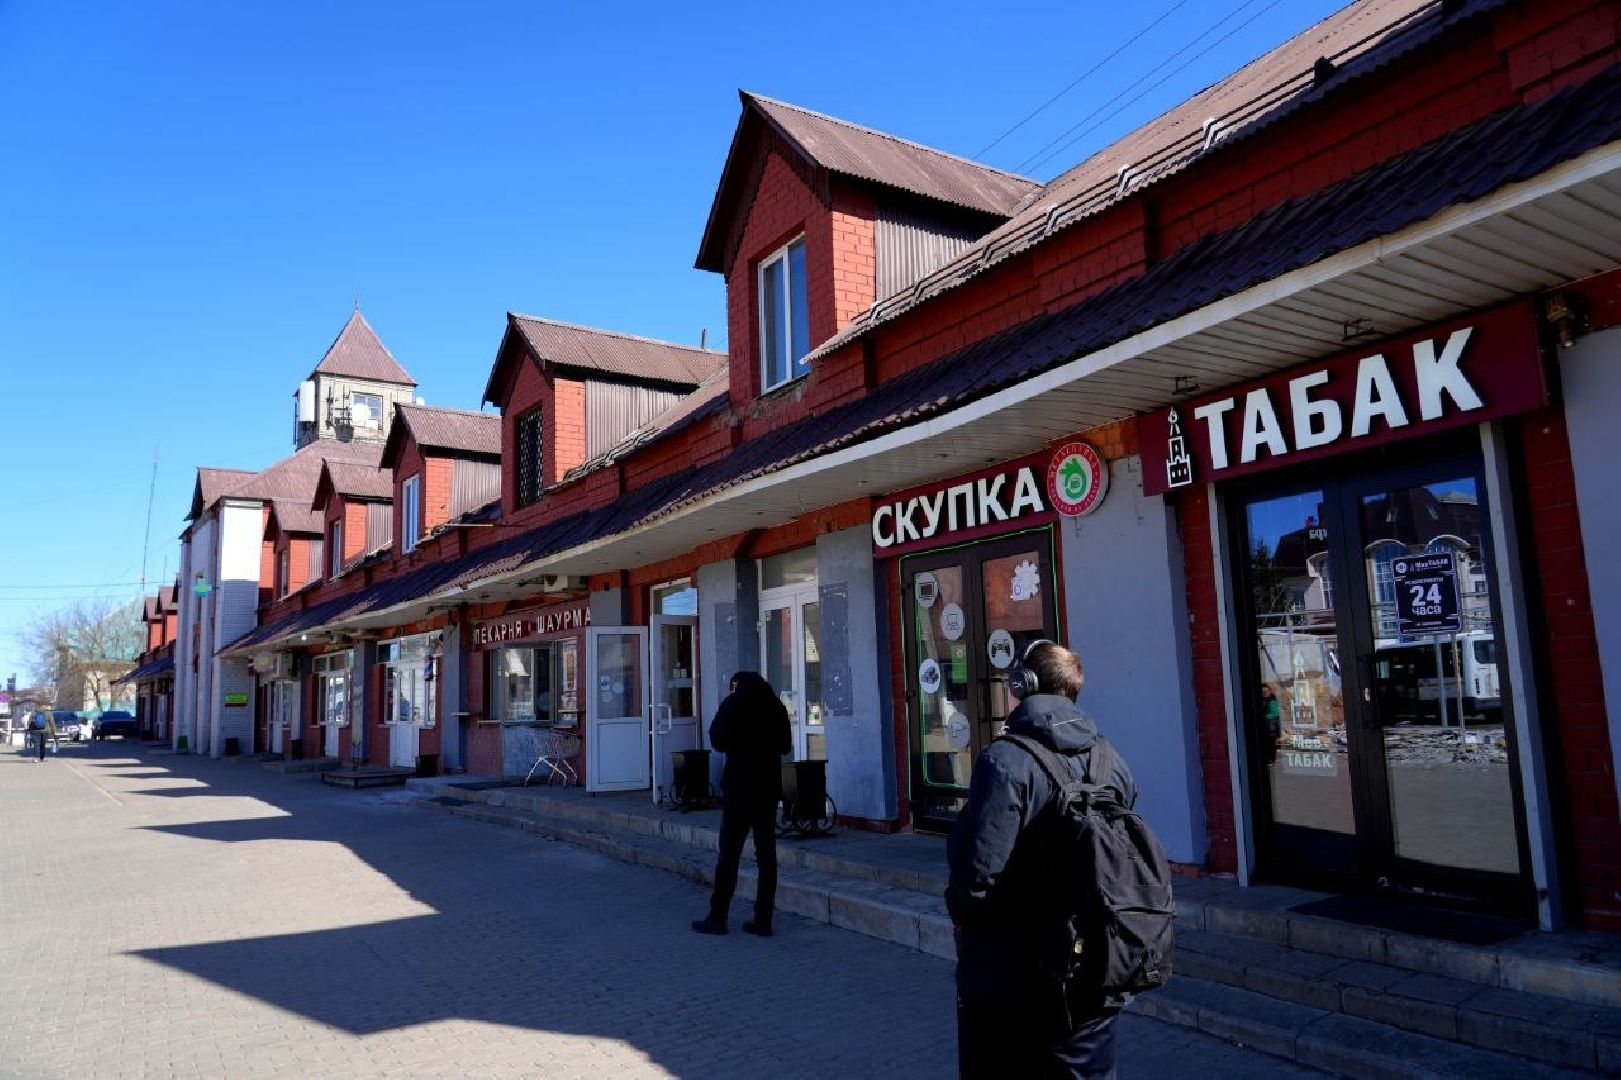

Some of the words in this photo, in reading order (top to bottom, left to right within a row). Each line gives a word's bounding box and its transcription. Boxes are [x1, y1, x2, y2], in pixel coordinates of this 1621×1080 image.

[1194, 326, 1485, 471] ТАБАК
[872, 466, 1045, 549] СКУПКА
[1409, 583, 1442, 607] 24
[1411, 605, 1442, 616] часа
[474, 620, 522, 645] ПЕКАРНЯ
[537, 606, 591, 634] ШАУРМА
[1286, 752, 1333, 768] ТАБАК
